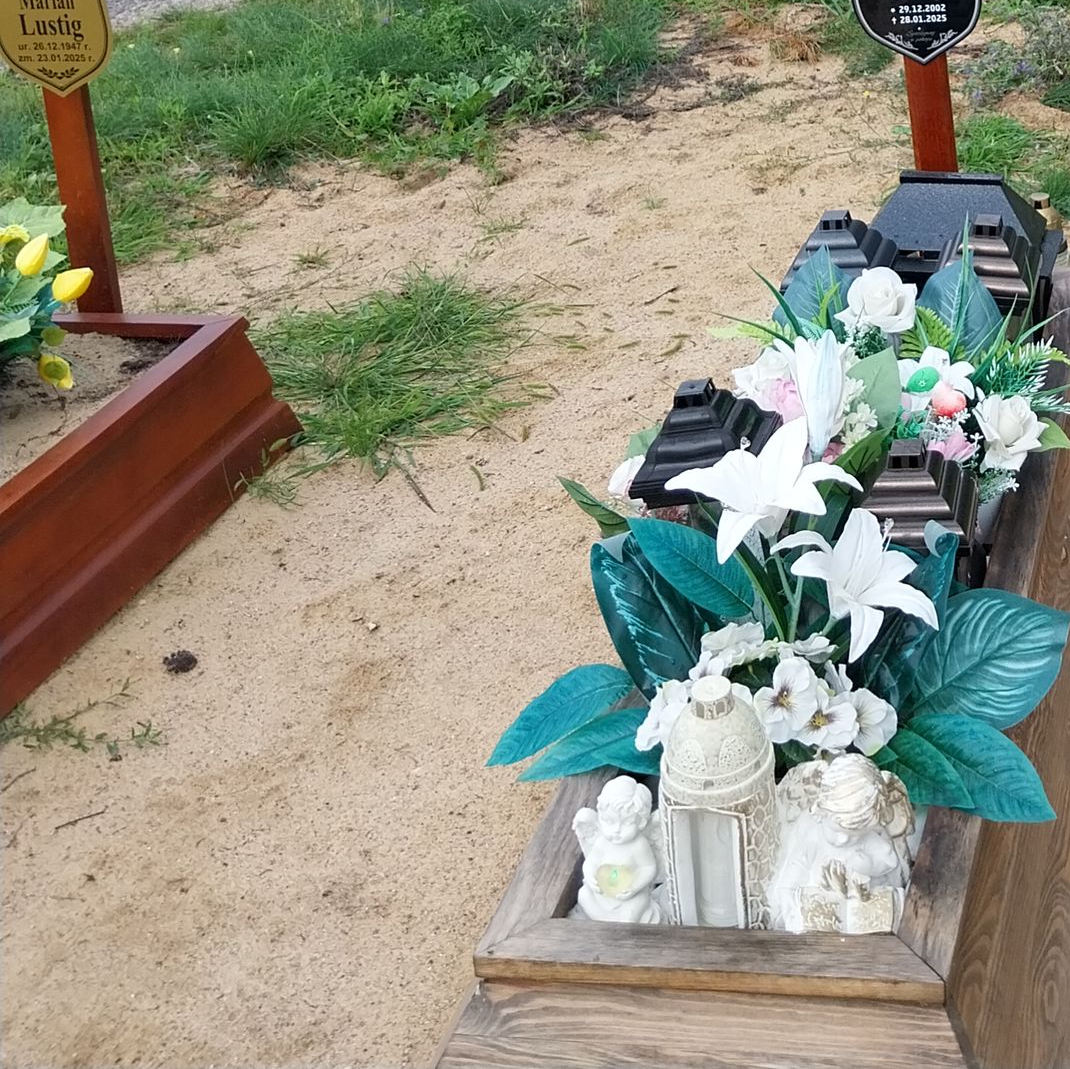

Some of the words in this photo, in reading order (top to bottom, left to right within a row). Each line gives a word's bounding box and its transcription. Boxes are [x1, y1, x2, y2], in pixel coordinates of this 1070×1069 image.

[898, 4, 947, 14] 29.12.2002
[899, 14, 947, 24] 28.01.2025
[18, 13, 84, 42] Lustig
[18, 43, 31, 51] ur.
[32, 42, 82, 51] 26.12.1947
[84, 43, 92, 51] r.
[18, 54, 36, 62] zm.
[37, 53, 86, 62] 23.01.2025
